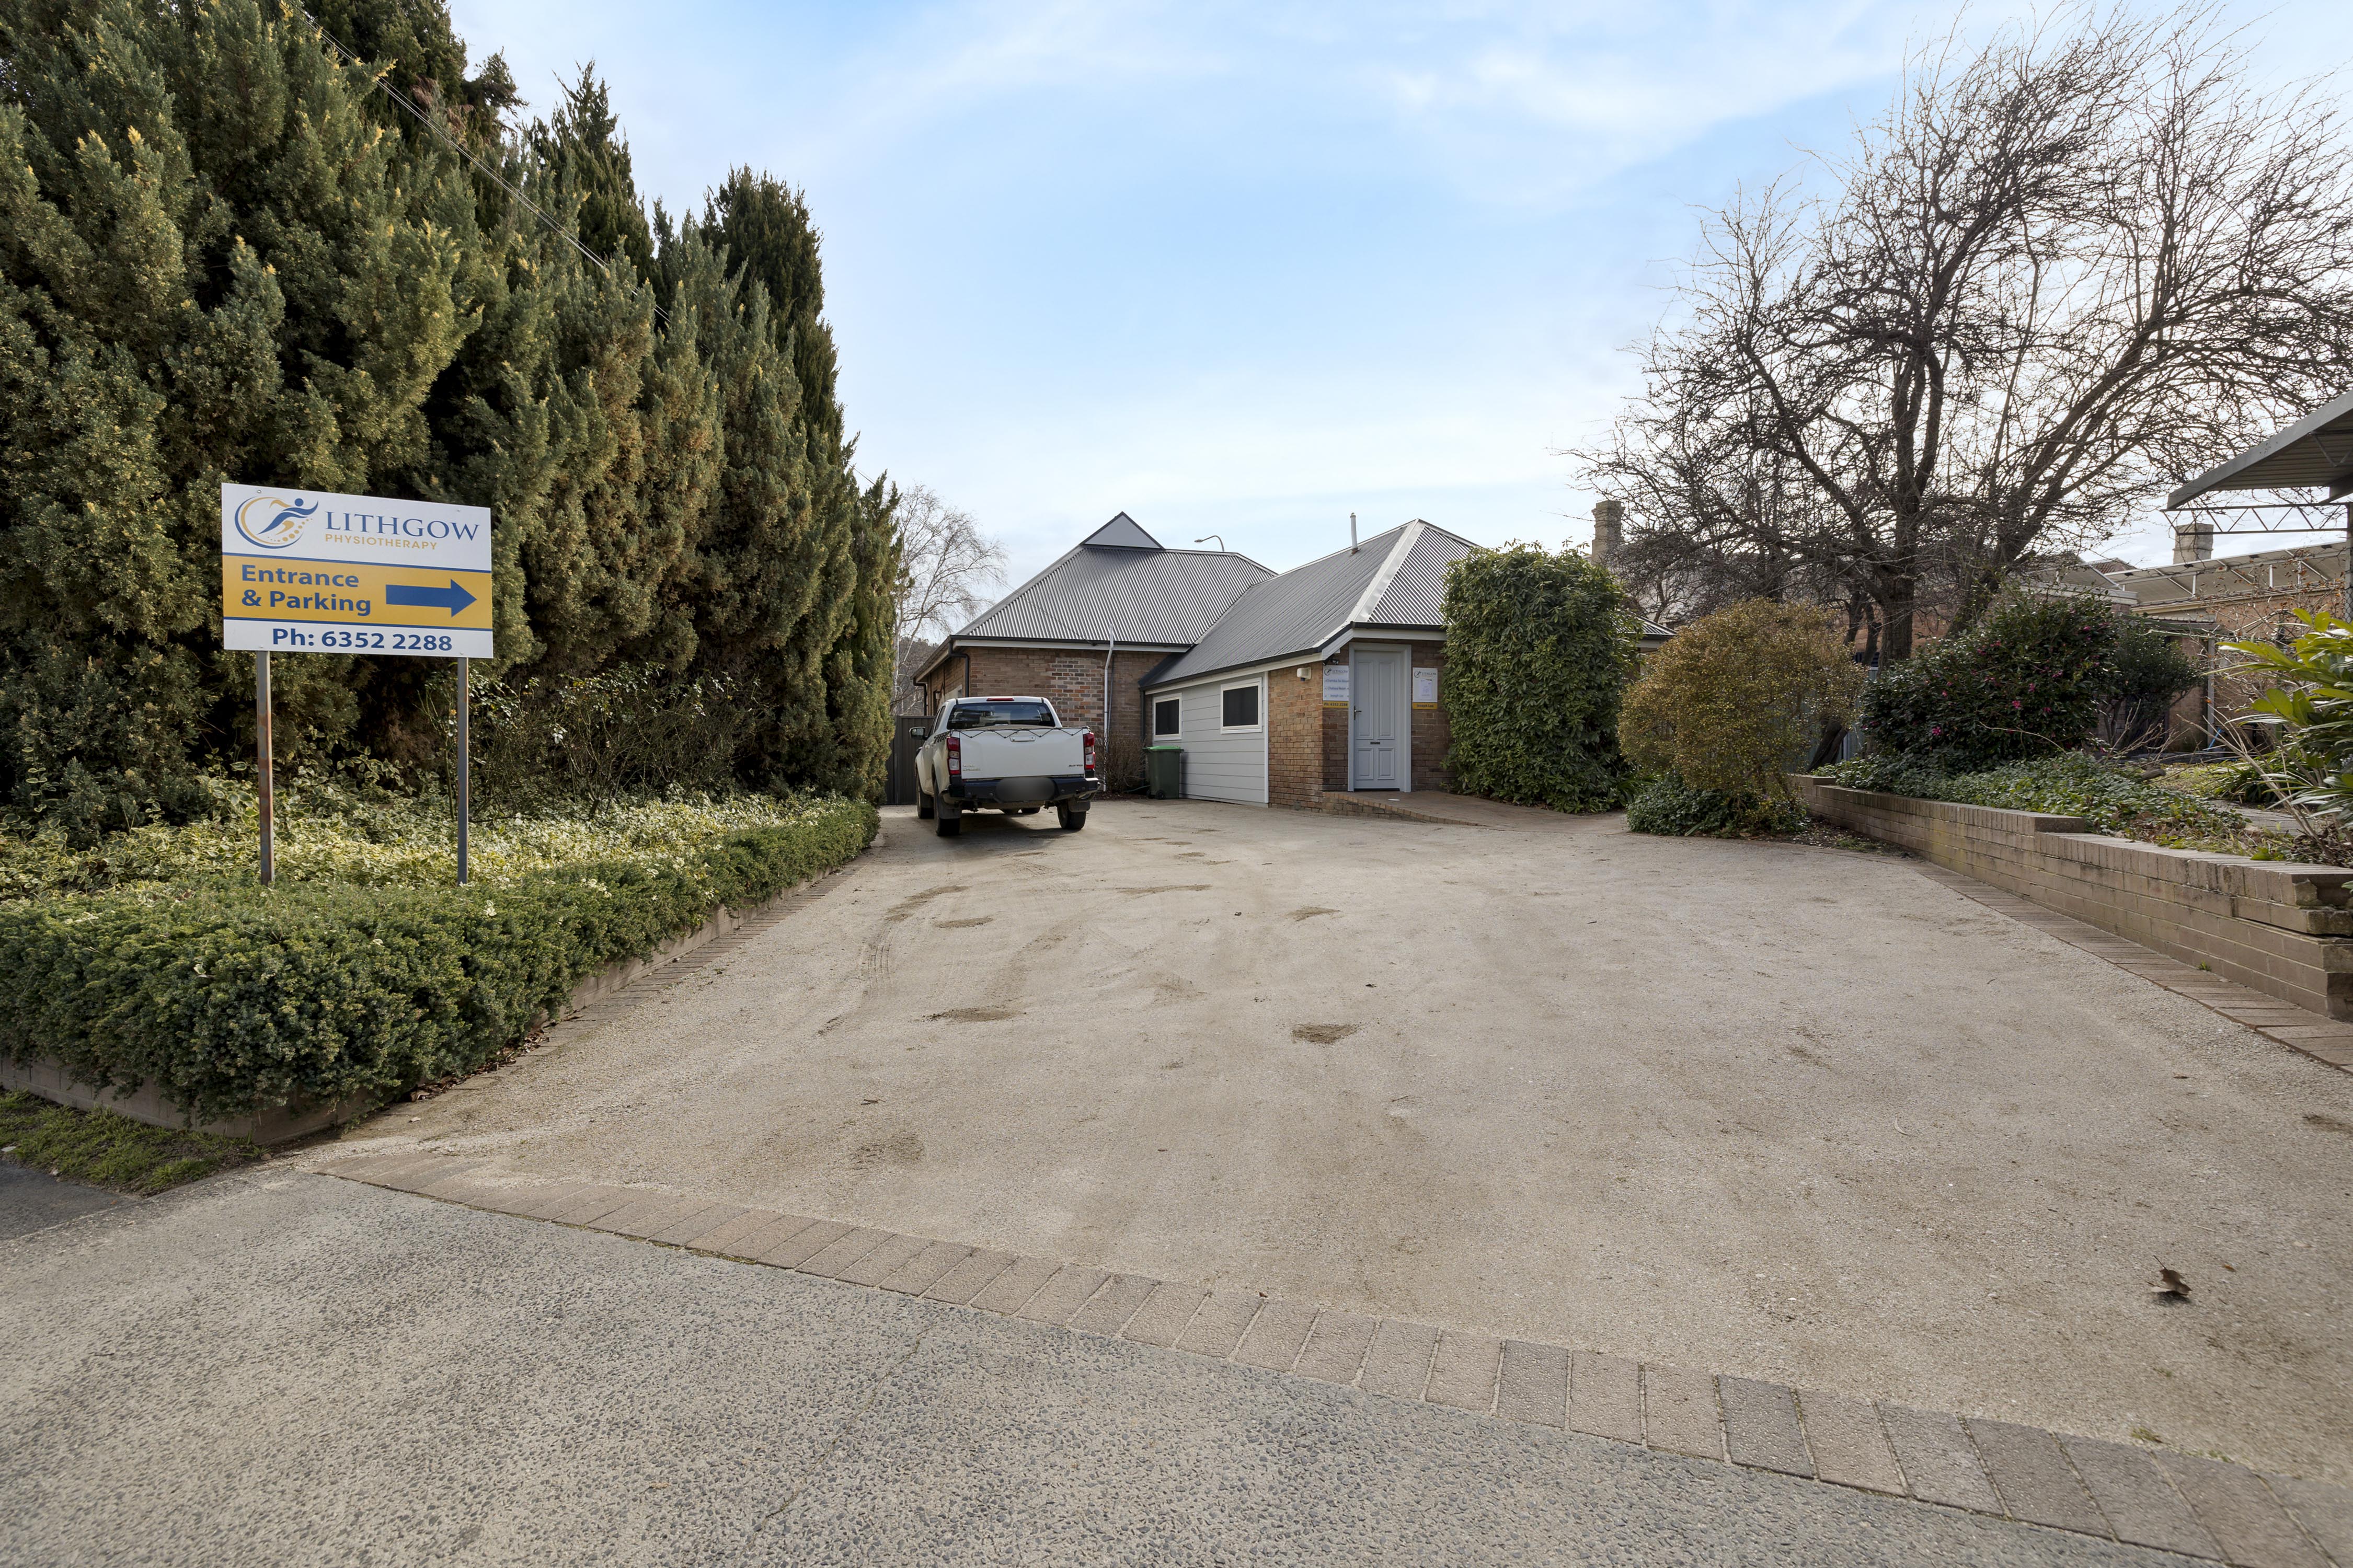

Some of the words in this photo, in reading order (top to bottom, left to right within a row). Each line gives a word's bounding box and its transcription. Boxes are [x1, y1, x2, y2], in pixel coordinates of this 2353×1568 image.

[325, 511, 479, 541] LITHGOW
[325, 534, 438, 550] PHYSIOTHERAPY
[242, 564, 359, 587] Entrance
[242, 589, 262, 607] &
[270, 591, 371, 616] Parking
[272, 628, 314, 647] Ph:
[321, 631, 385, 649] 6352
[392, 633, 452, 651] 2288
